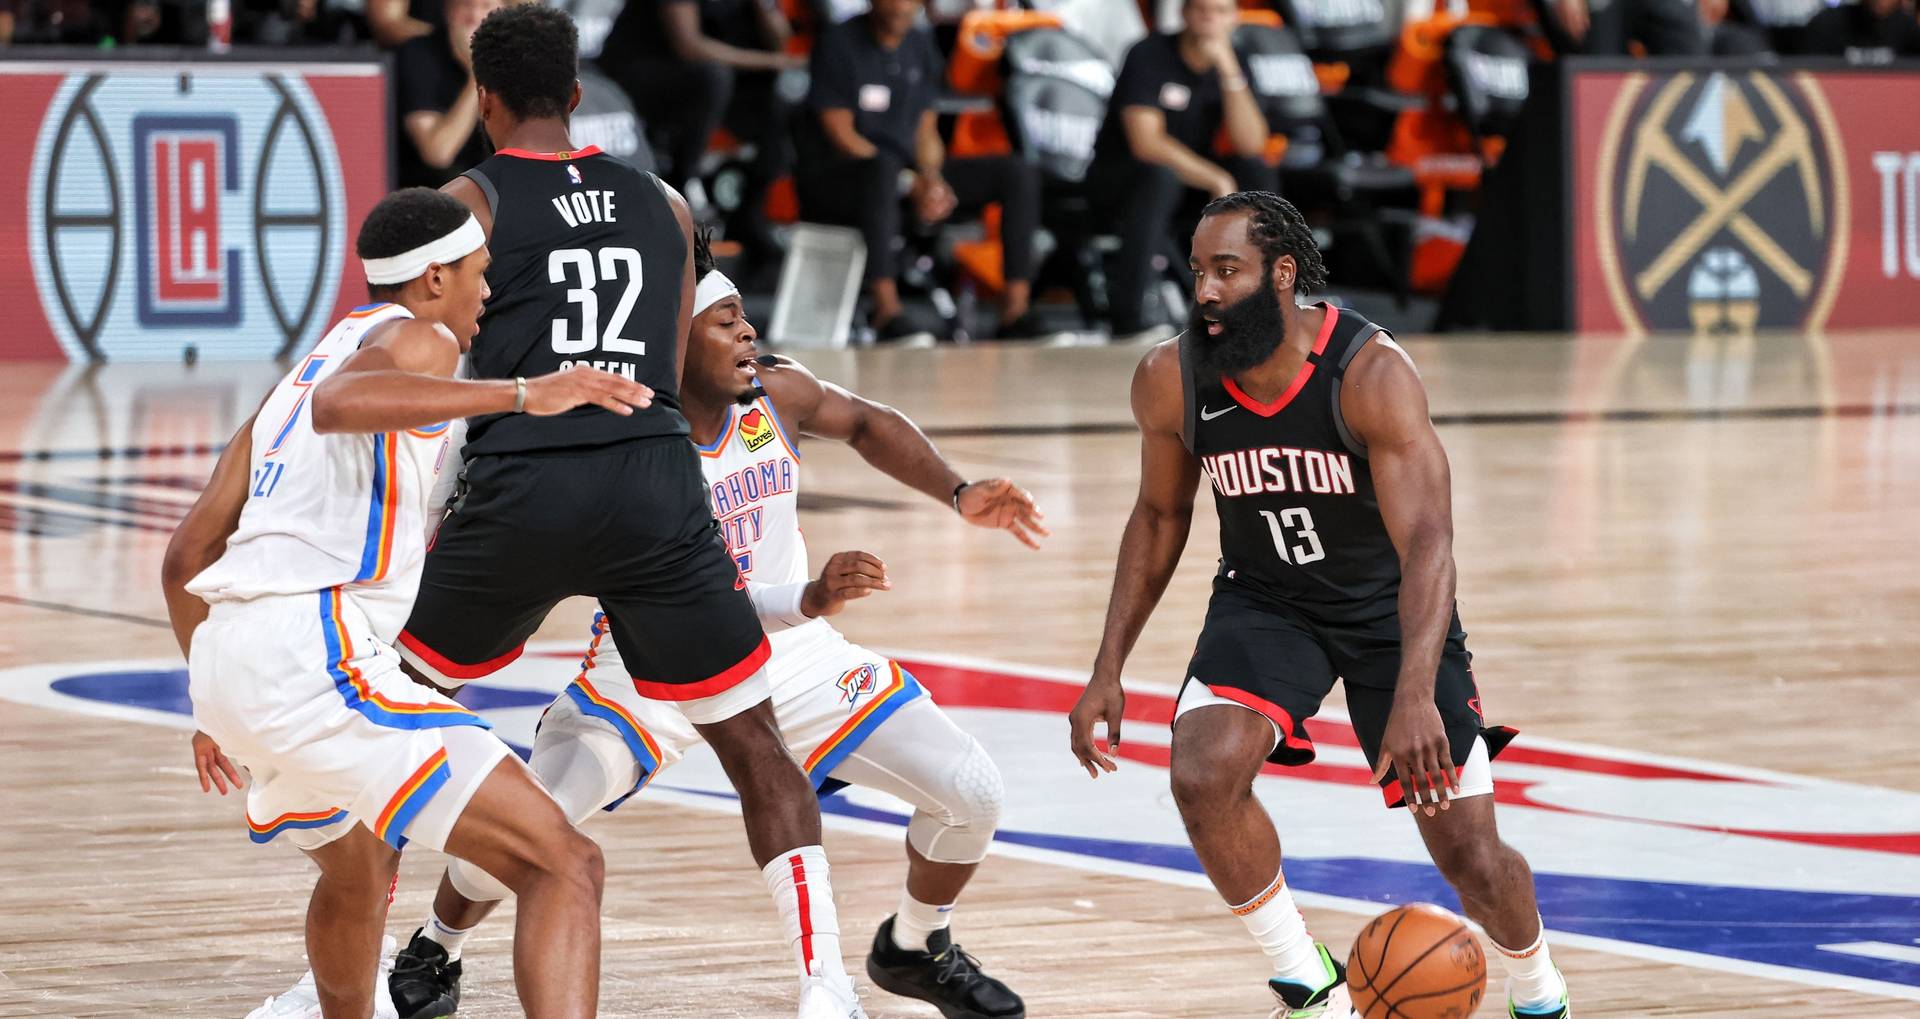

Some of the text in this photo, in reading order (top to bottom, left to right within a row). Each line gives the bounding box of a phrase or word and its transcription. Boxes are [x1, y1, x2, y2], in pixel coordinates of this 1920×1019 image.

[552, 189, 617, 228] VOTE
[548, 247, 646, 356] 32
[712, 456, 793, 519] AHOMA
[1201, 446, 1356, 497] HOUSTON
[722, 505, 763, 551] ITY
[1258, 506, 1326, 566] 13
[845, 666, 870, 703] OKC
